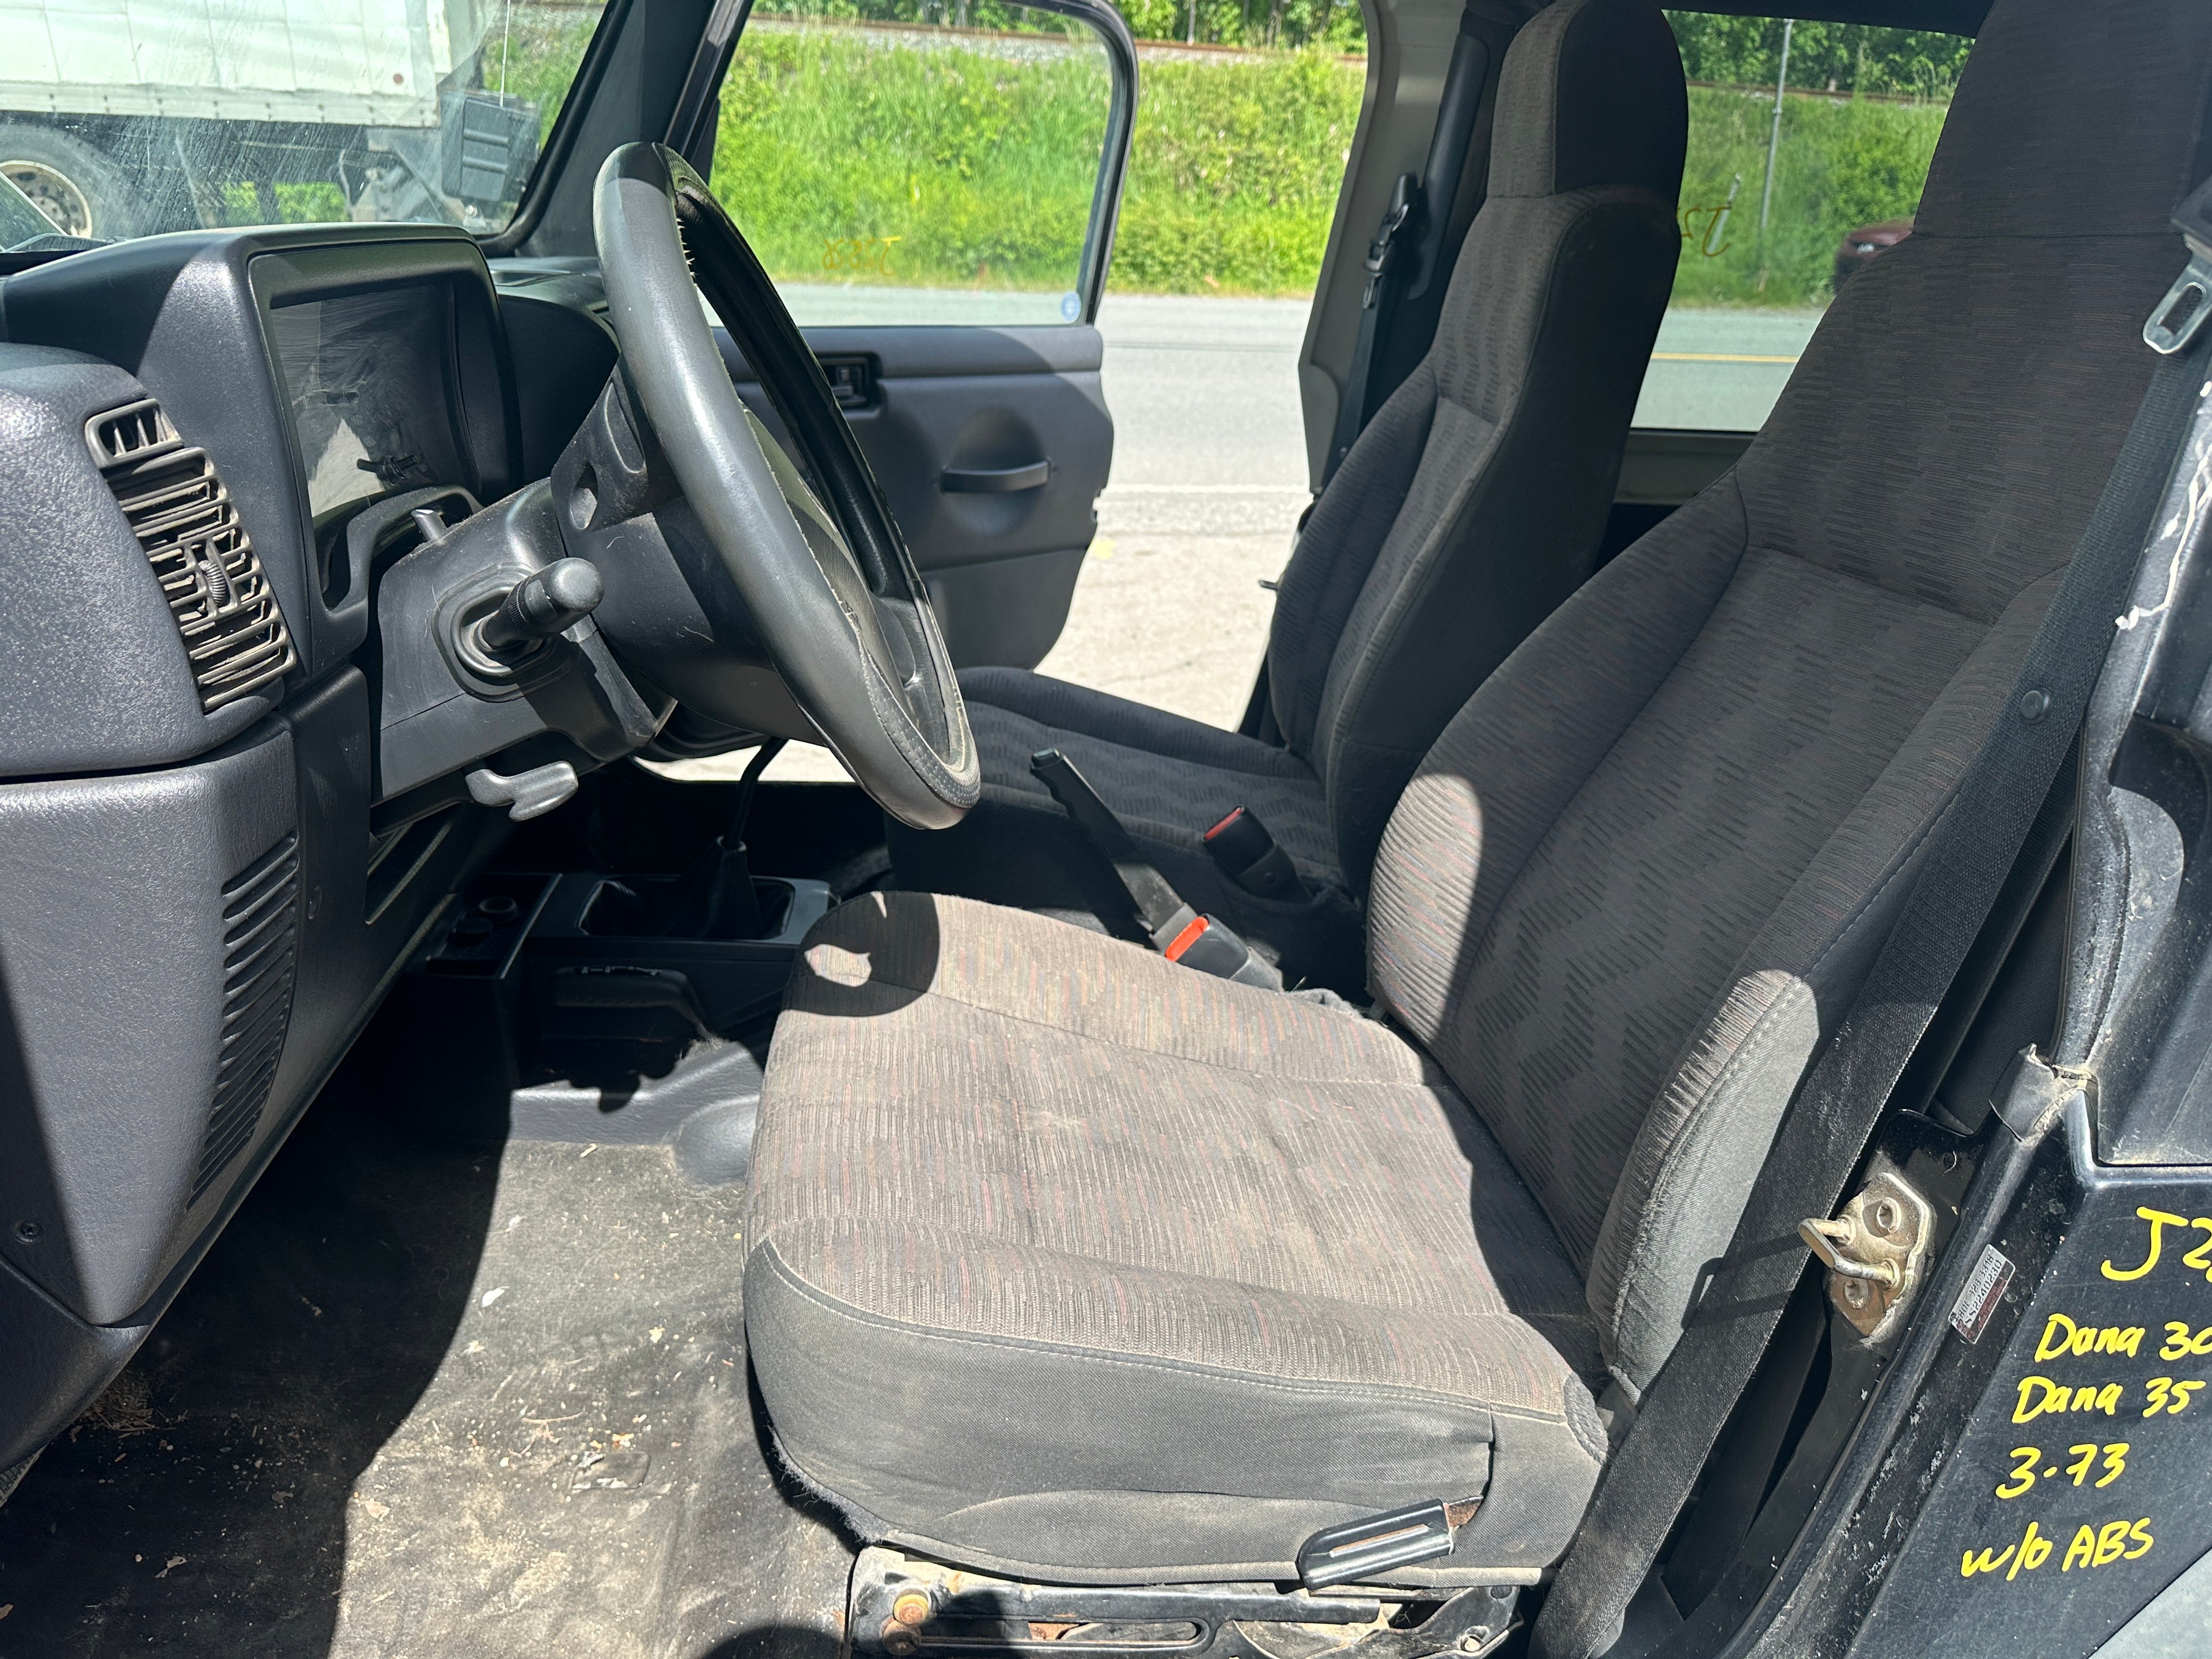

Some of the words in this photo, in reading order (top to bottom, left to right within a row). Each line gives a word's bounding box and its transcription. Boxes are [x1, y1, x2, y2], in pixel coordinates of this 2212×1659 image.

[2035, 1313, 2145, 1362] Dana
[2160, 1321, 2212, 1361] 30
[2012, 1376, 2123, 1423] Dana
[2142, 1377, 2206, 1417] 35
[1960, 1521, 2053, 1581] w/o
[2062, 1517, 2154, 1571] ABS
